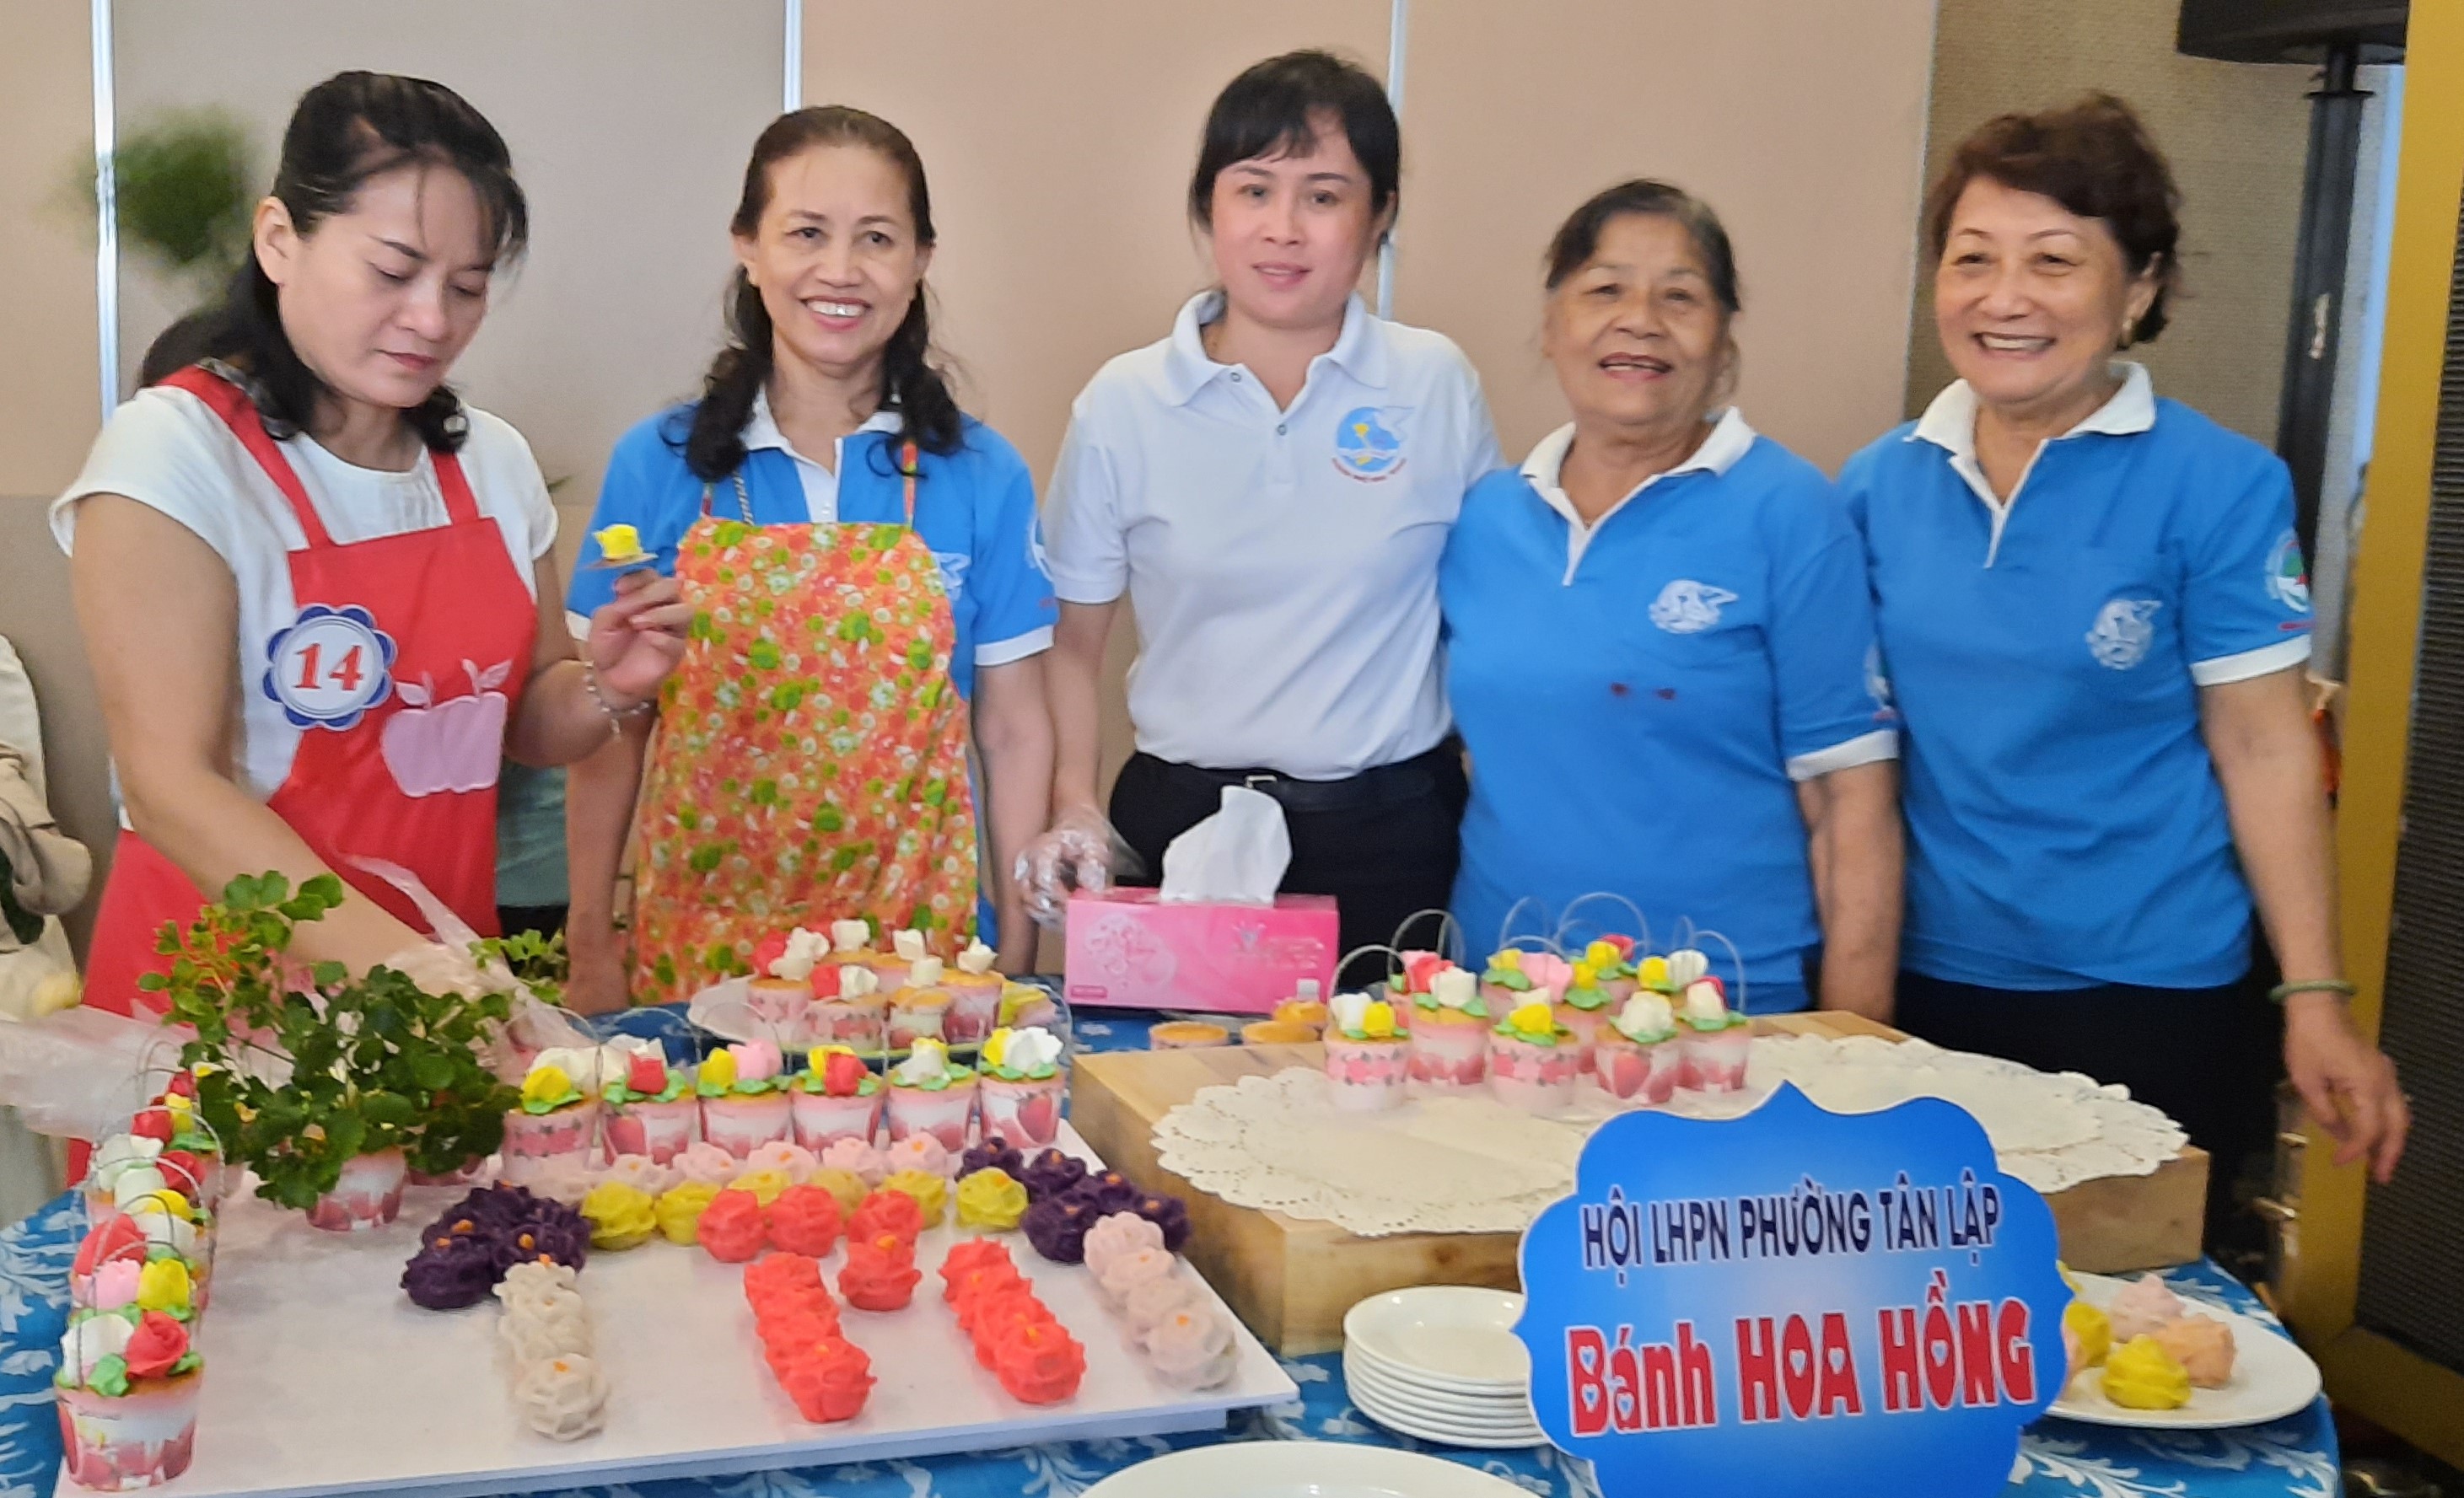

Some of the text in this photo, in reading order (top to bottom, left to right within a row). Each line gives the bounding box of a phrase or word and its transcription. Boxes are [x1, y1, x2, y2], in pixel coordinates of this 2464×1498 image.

[293, 643, 363, 690] 14
[1583, 1168, 1999, 1286] HỘI LHPN PHƯỜNG TÂN LẬP
[1568, 1270, 2036, 1435] Bánh HOA HỒNG
